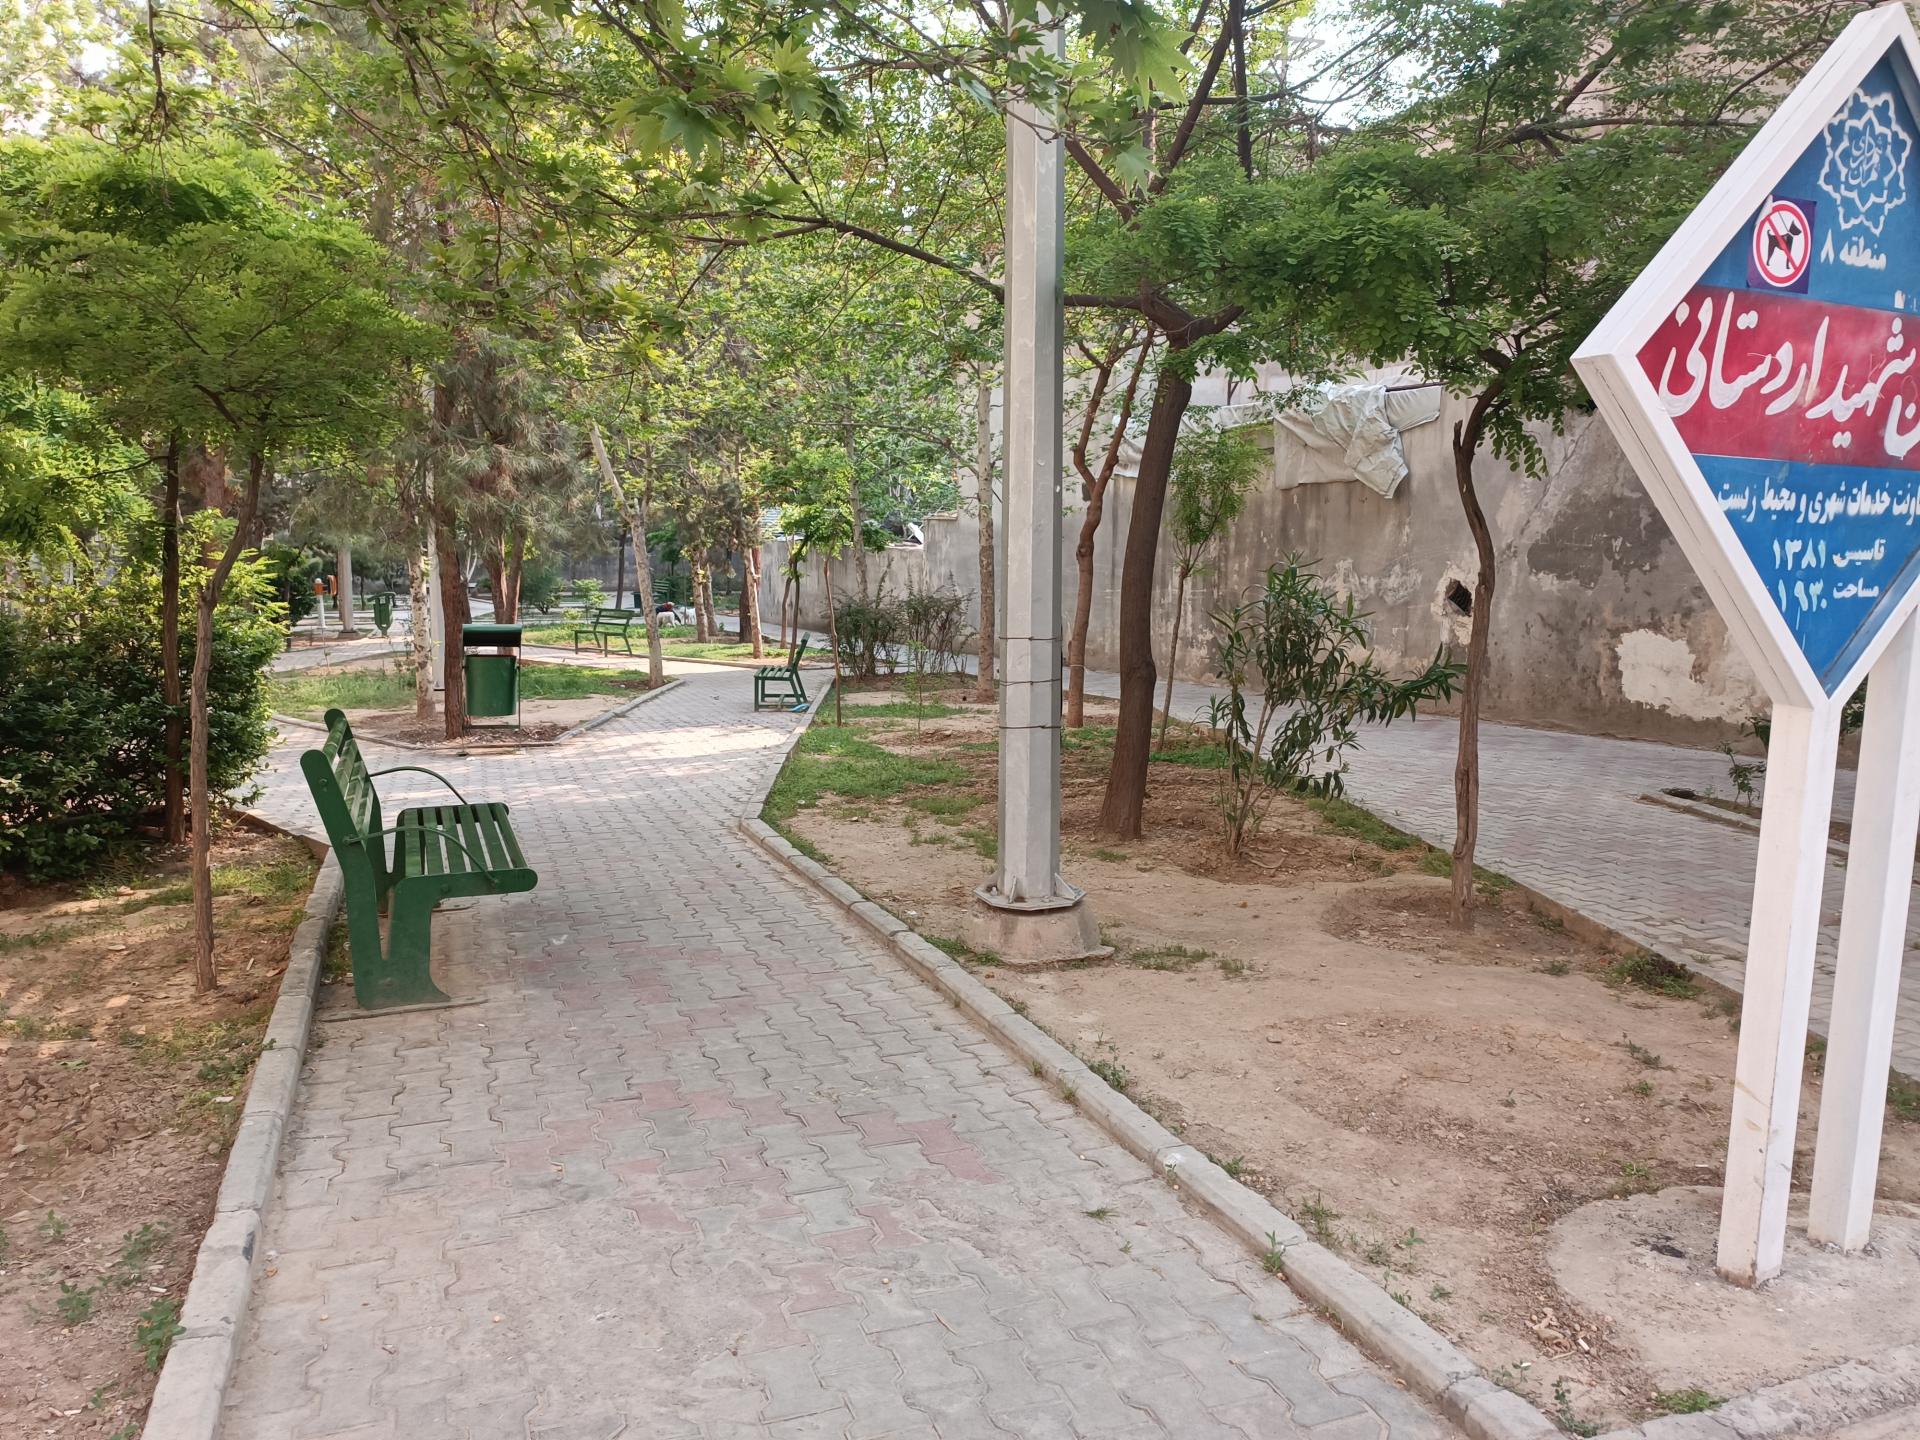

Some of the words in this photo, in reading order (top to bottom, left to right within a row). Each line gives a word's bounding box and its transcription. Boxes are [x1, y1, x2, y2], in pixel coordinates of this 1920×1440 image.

[1820, 228, 1835, 265] ۸
[1839, 235, 1887, 270] منطقه
[1659, 291, 1829, 418] اردستانی
[1805, 317, 1917, 448] شهید
[1718, 483, 1757, 522] زیست
[1760, 476, 1796, 520] محیط
[1796, 493, 1807, 523] و
[1808, 480, 1846, 524] شهری
[1847, 479, 1890, 516] خدمات
[1892, 482, 1920, 526] اونت
[1772, 537, 1827, 571] ۱۳۸۱
[1832, 577, 1879, 599] مساحت
